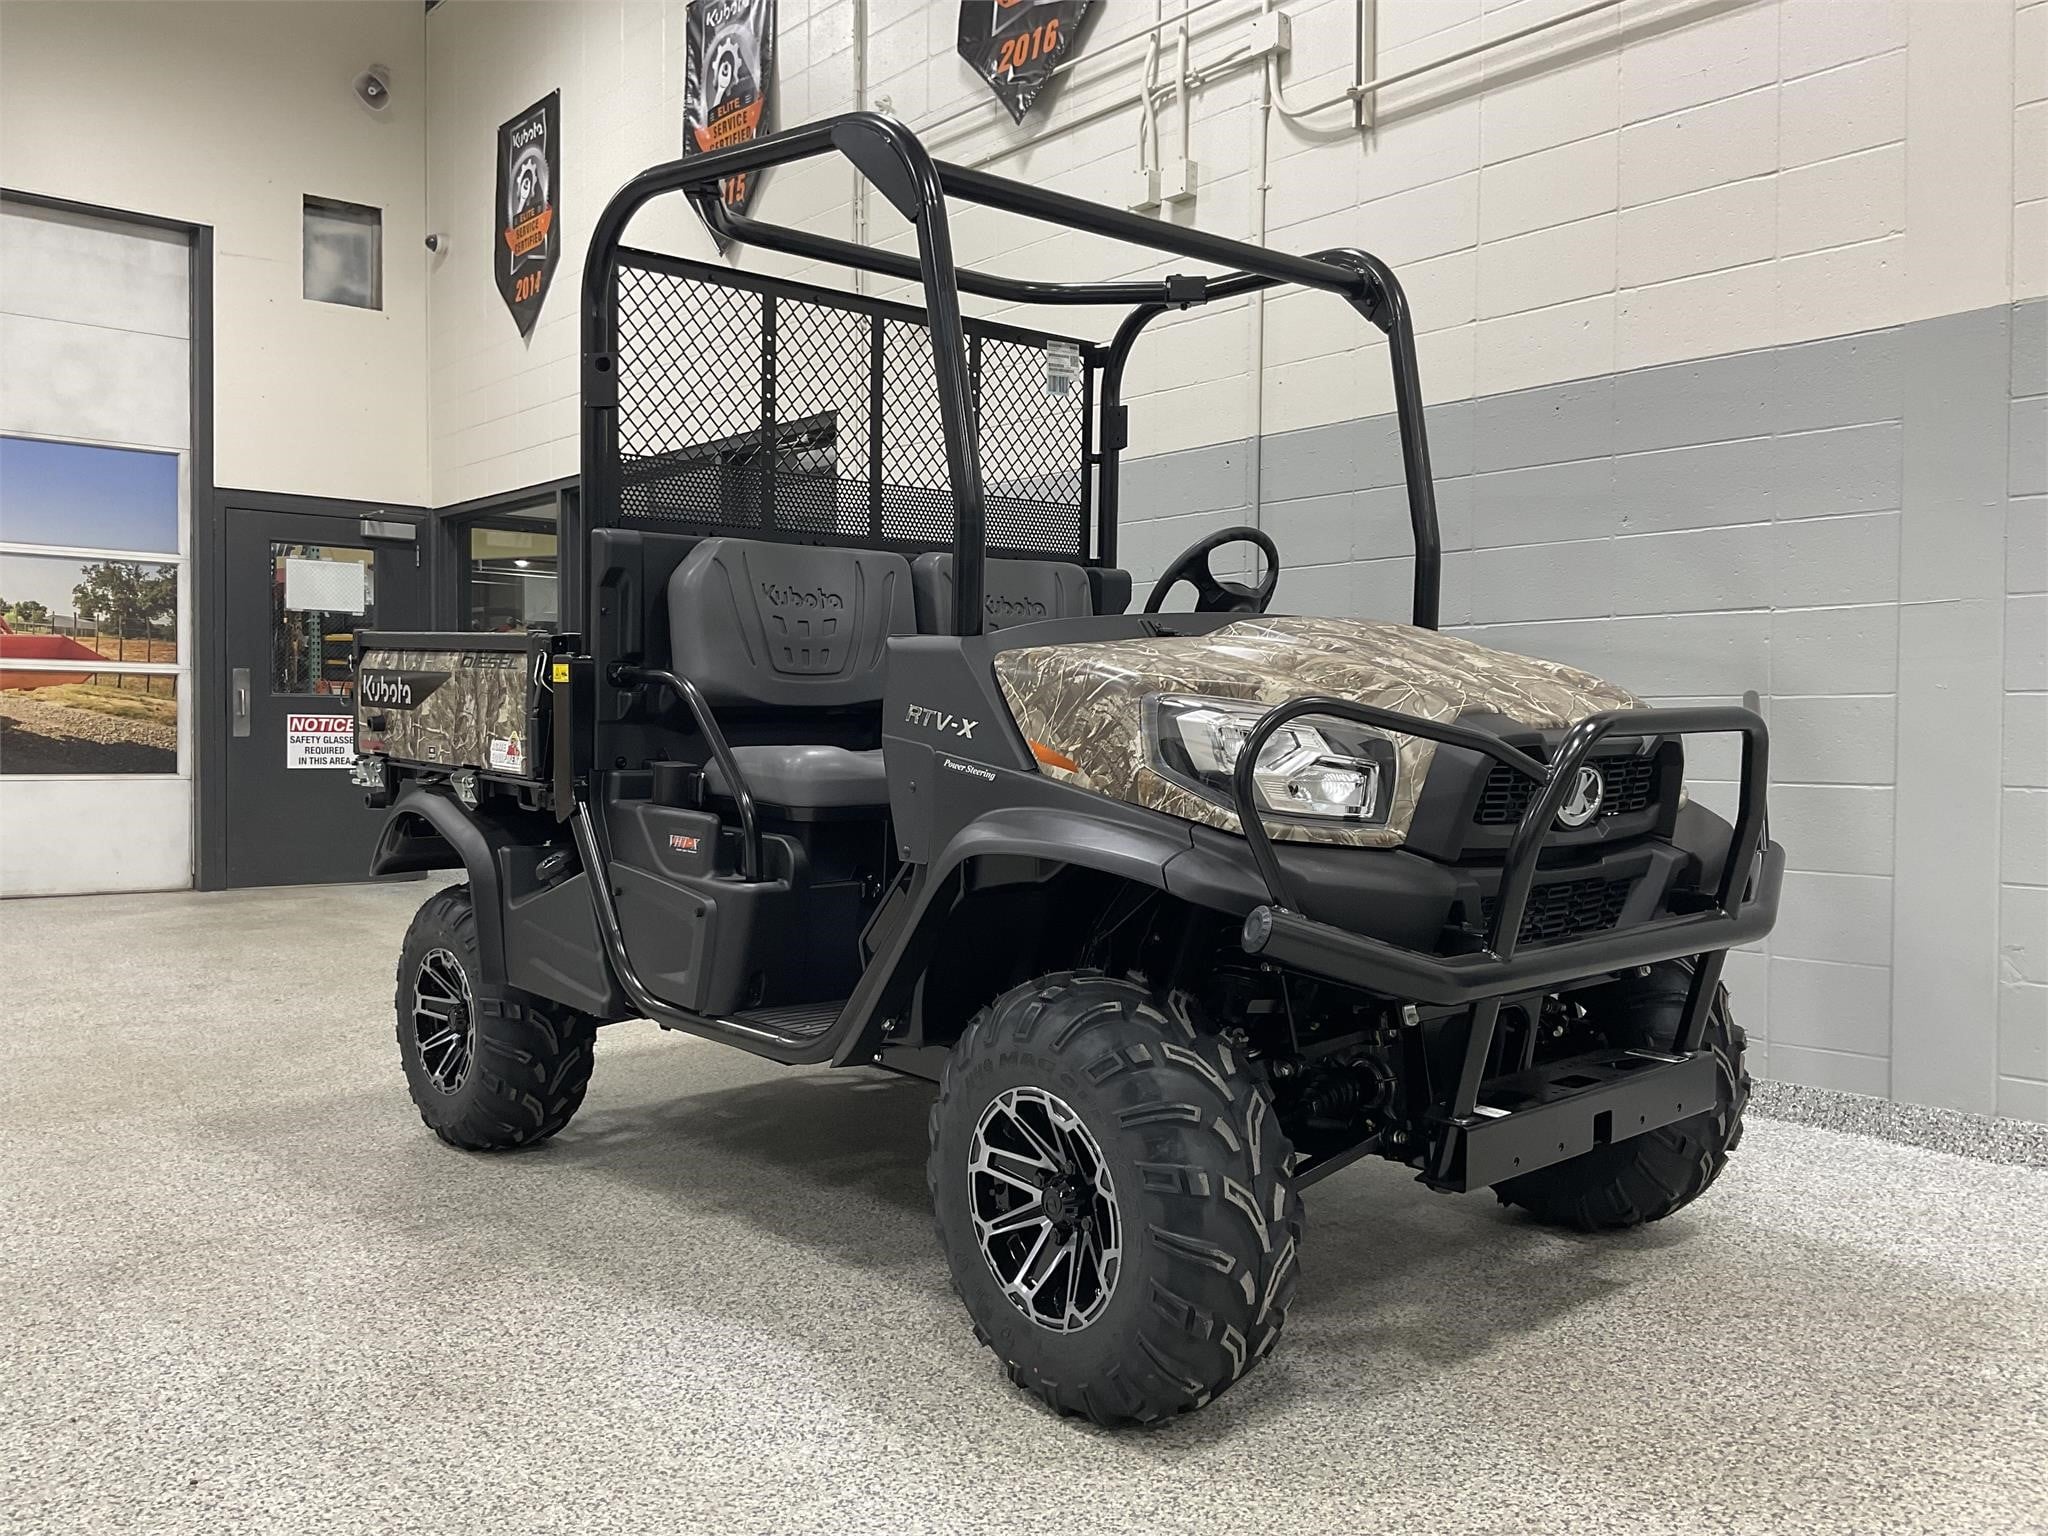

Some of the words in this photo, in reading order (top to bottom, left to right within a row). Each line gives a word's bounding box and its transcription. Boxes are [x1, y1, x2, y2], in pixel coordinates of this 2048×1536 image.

[997, 18, 1060, 74] 2016
[718, 98, 740, 116] ELITE
[512, 121, 544, 149] Kubota
[713, 111, 748, 139] SERVICE
[516, 219, 539, 240] SERVICE
[514, 231, 543, 253] CERTIFIED
[515, 270, 542, 303] 2014
[761, 582, 844, 609] Kubota
[984, 594, 1047, 617] Kubota
[462, 656, 519, 669] DIESEL
[363, 674, 412, 705] Kubota
[291, 718, 354, 732] NOTICE
[905, 704, 979, 739] RTV-X
[290, 736, 321, 744] SAFETY
[323, 736, 354, 744] GLASSE
[305, 747, 345, 755] REQUIRED
[299, 757, 307, 765] IN
[309, 757, 328, 765] THIS
[943, 759, 967, 771] Power
[965, 764, 996, 781] Steering
